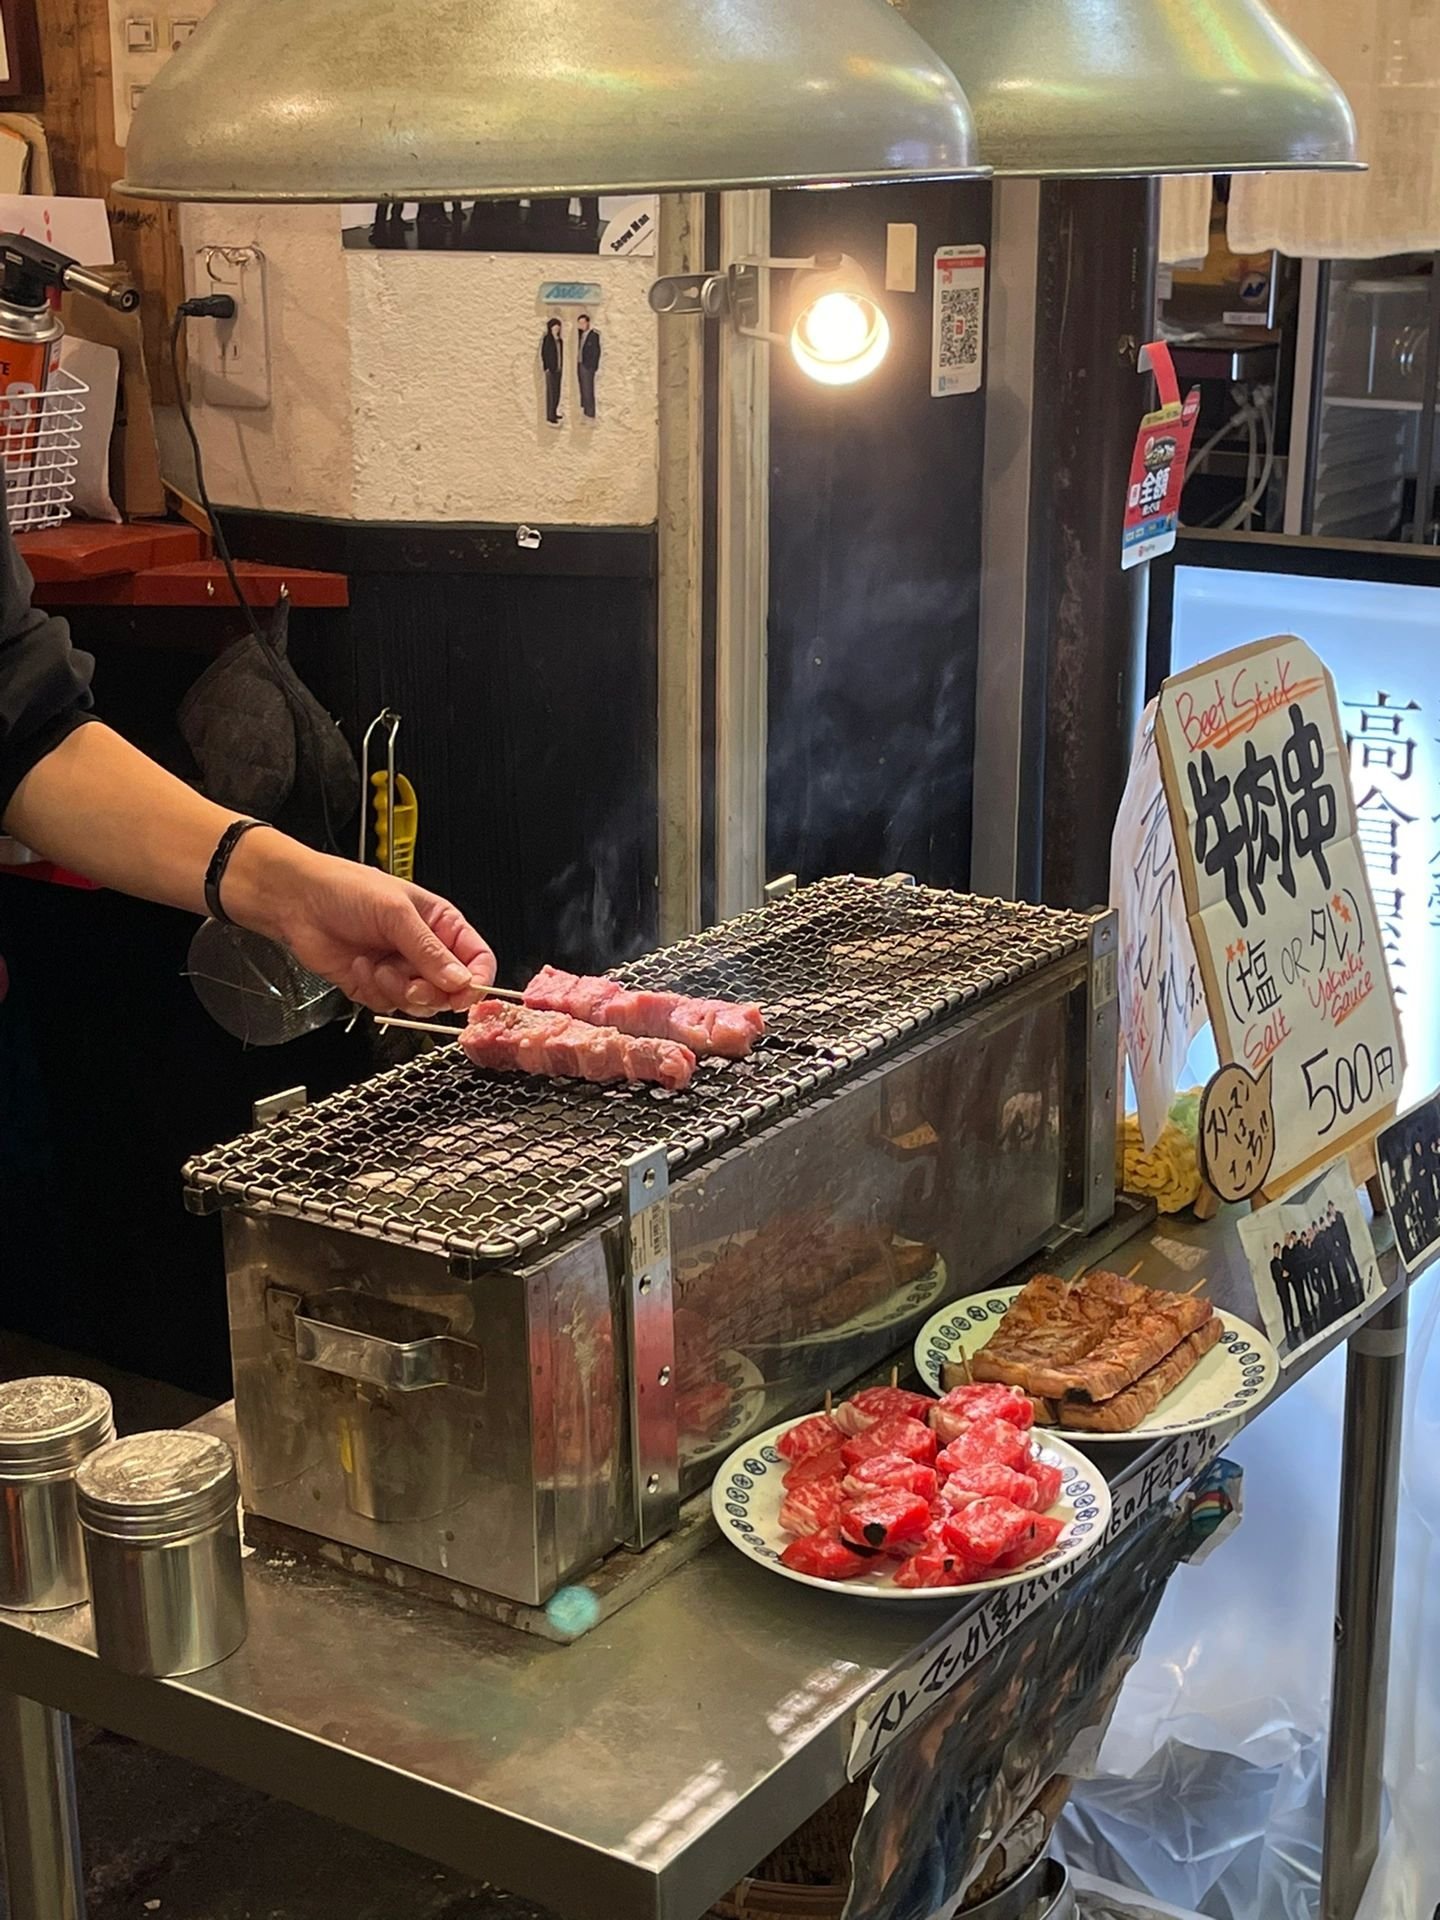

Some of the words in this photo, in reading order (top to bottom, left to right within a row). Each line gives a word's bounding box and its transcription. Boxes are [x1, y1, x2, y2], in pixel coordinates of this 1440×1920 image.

[1175, 679, 1232, 753] Beef
[1231, 657, 1298, 733] Stick
[1187, 703, 1337, 928] 牛肉串
[1281, 937, 1311, 985] OR
[1244, 1008, 1292, 1068] Salt
[1301, 1043, 1394, 1136] 500円
